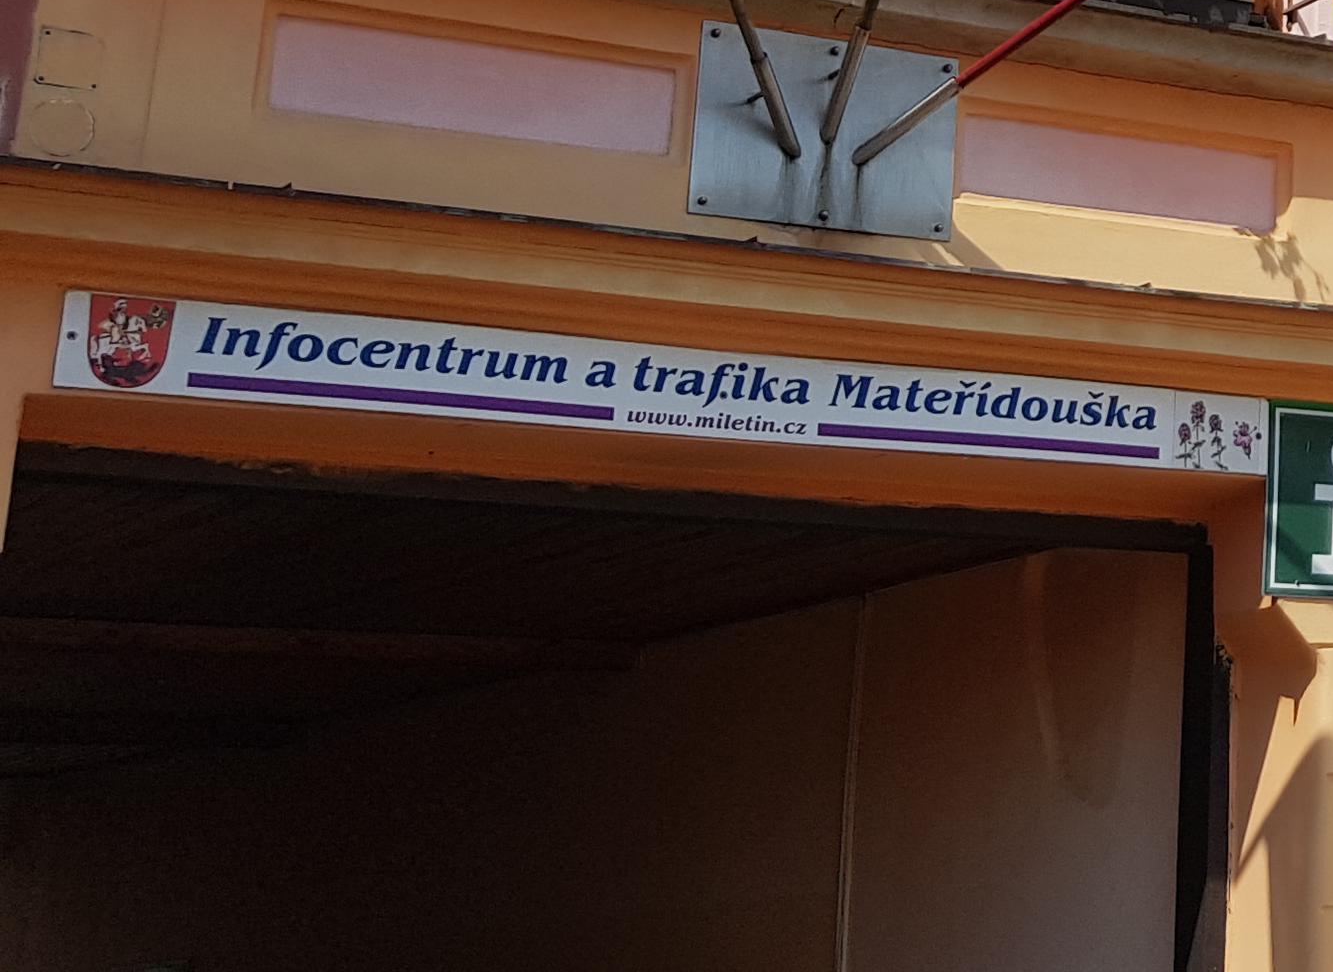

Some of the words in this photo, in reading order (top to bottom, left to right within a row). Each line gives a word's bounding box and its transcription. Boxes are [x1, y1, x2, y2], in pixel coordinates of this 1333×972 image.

[195, 316, 568, 384] Infocentrum
[584, 360, 617, 389] a
[632, 355, 810, 408] trafika
[829, 373, 1157, 430] Mateřídouška
[627, 408, 808, 436] www.miletin.cz
